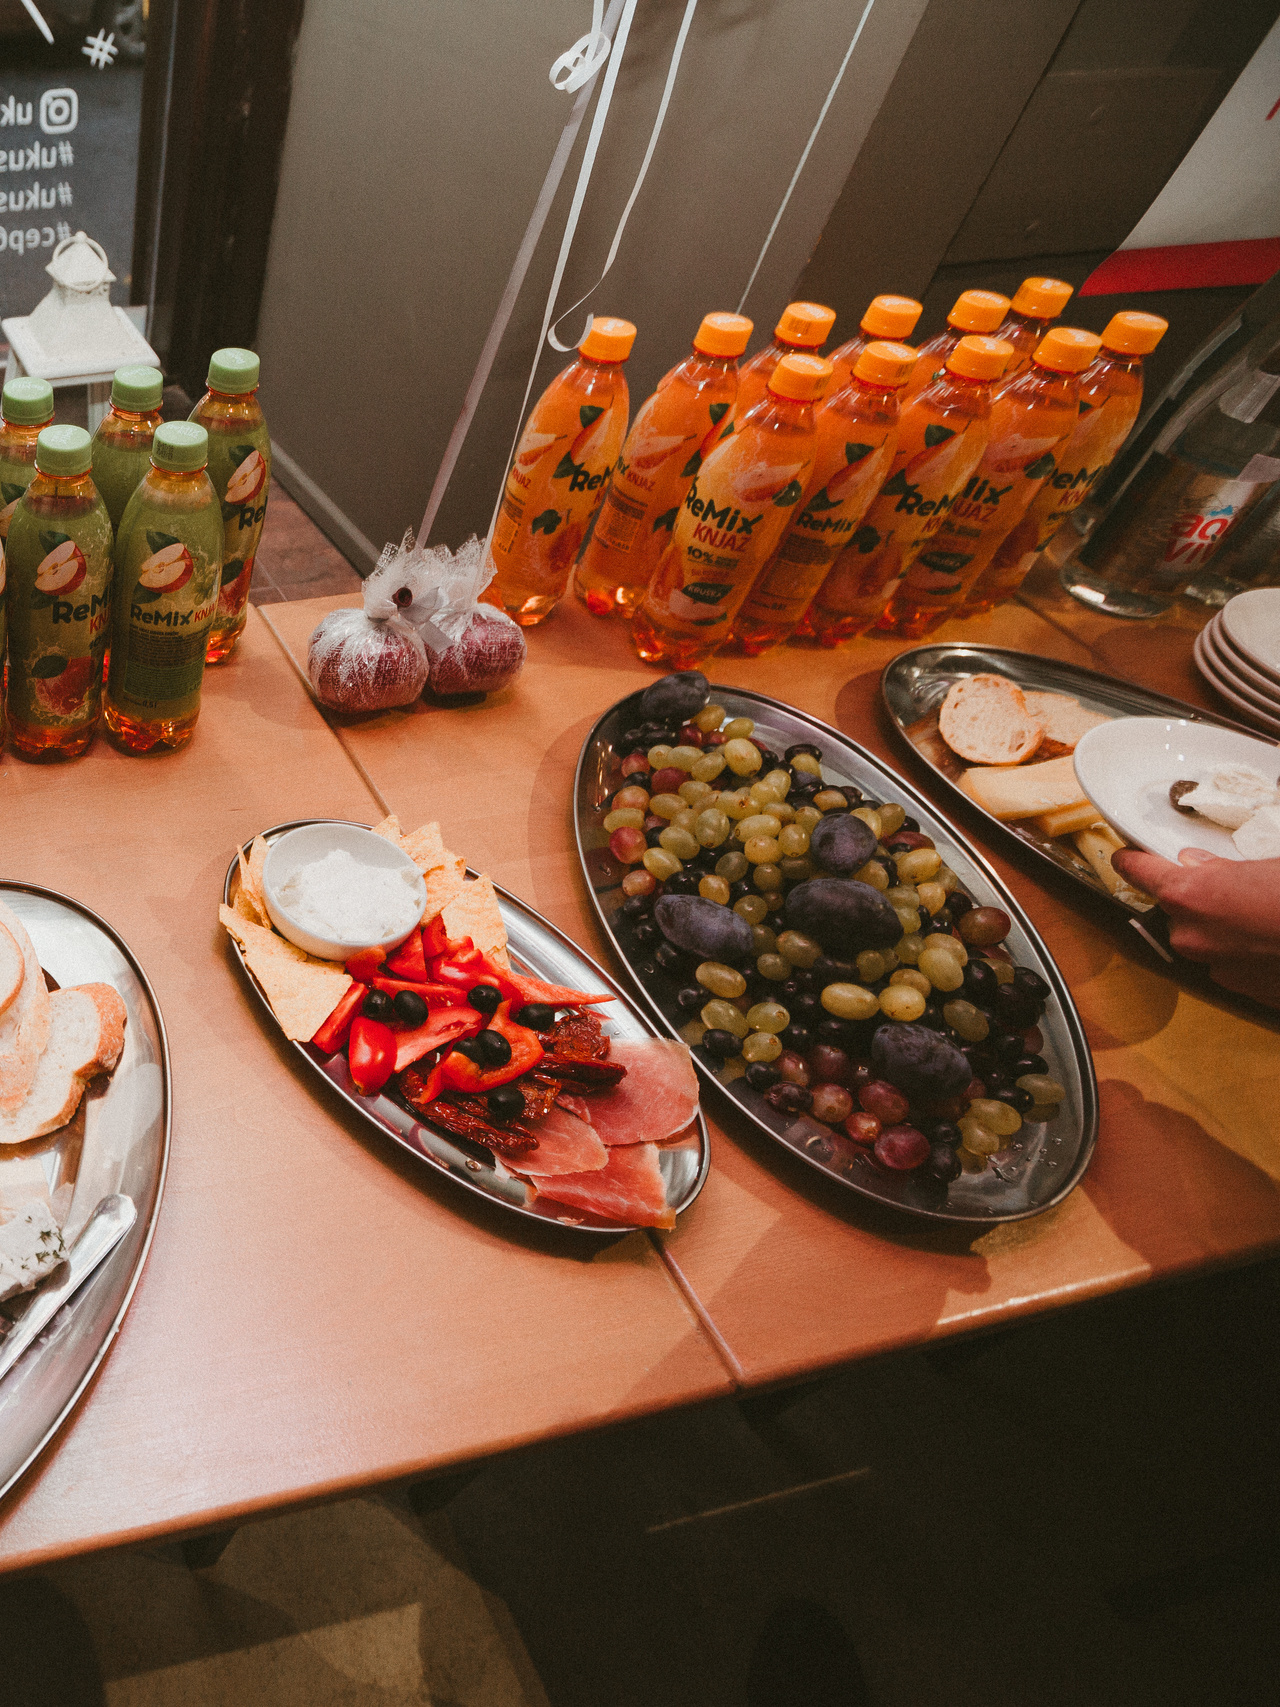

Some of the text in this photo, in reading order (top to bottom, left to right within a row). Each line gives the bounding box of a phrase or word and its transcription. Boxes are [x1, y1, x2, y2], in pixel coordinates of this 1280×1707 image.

[693, 522, 751, 553] KNJAZ
[687, 546, 714, 564] 10%
[130, 603, 194, 627] ReMix
